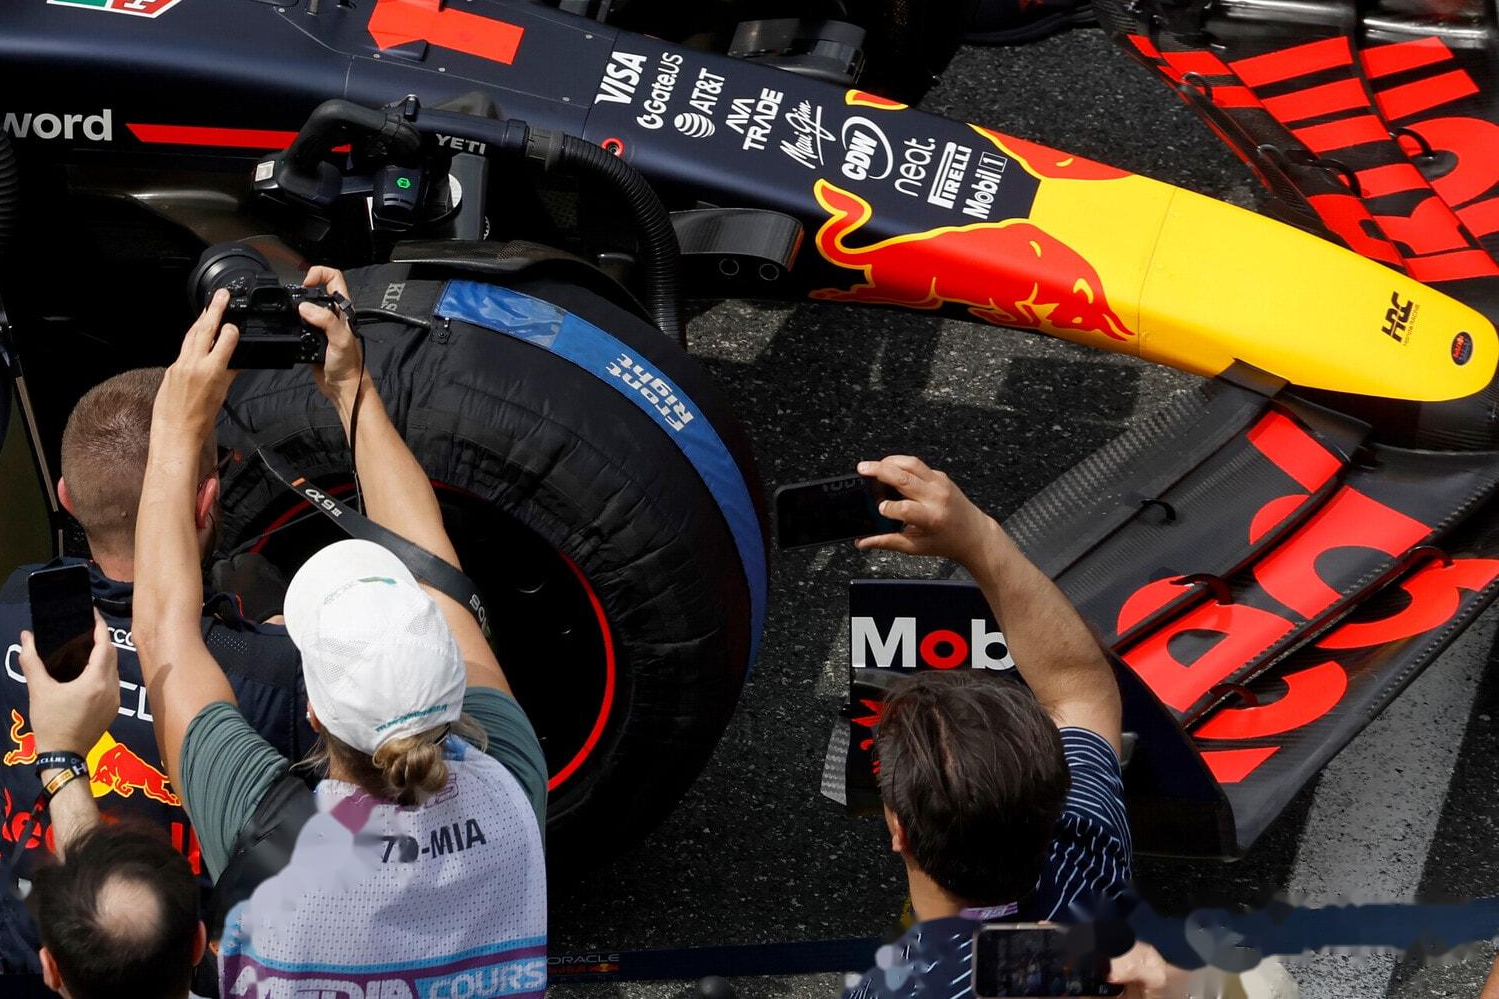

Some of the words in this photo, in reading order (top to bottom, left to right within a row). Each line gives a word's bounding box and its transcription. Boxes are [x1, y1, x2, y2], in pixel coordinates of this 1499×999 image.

[595, 51, 648, 104] VISA
[643, 52, 684, 115] Gate.US
[689, 68, 725, 115] AT&T
[725, 98, 756, 134] AVA
[743, 87, 784, 151] TRADE
[435, 133, 487, 155] YETI
[841, 129, 878, 181] CDW
[927, 141, 973, 210] PIRELLI
[962, 168, 1002, 220] Mobil
[1381, 291, 1414, 343] HRC
[605, 360, 684, 432] Front
[617, 351, 694, 424] Right
[851, 617, 1016, 671] Mob
